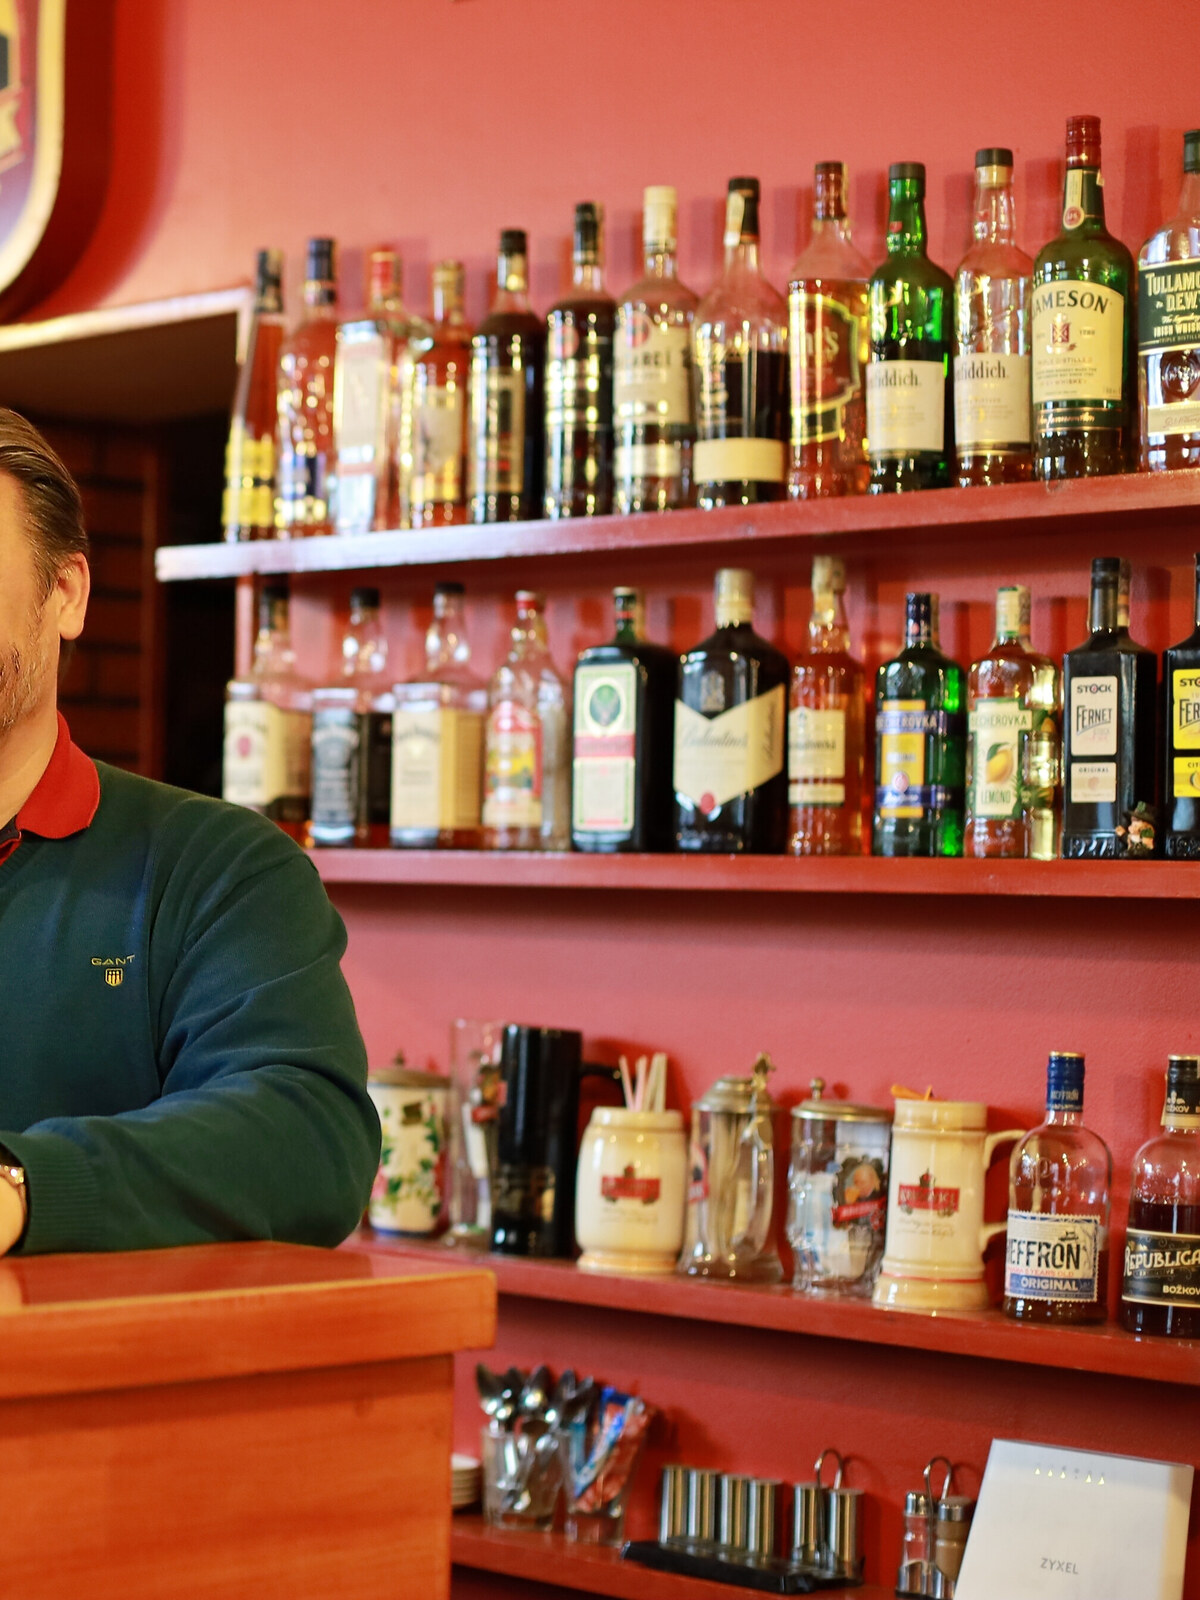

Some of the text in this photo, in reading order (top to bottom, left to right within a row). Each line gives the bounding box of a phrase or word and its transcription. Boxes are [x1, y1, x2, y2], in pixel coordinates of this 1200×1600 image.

[1077, 684, 1112, 694] STOCK
[971, 714, 1027, 727] BECHEROVKA
[1077, 705, 1112, 732] FERNET
[91, 954, 136, 966] GANT
[1020, 1276, 1079, 1291] ORIGINAL
[1040, 1557, 1079, 1575] ZYXEL
